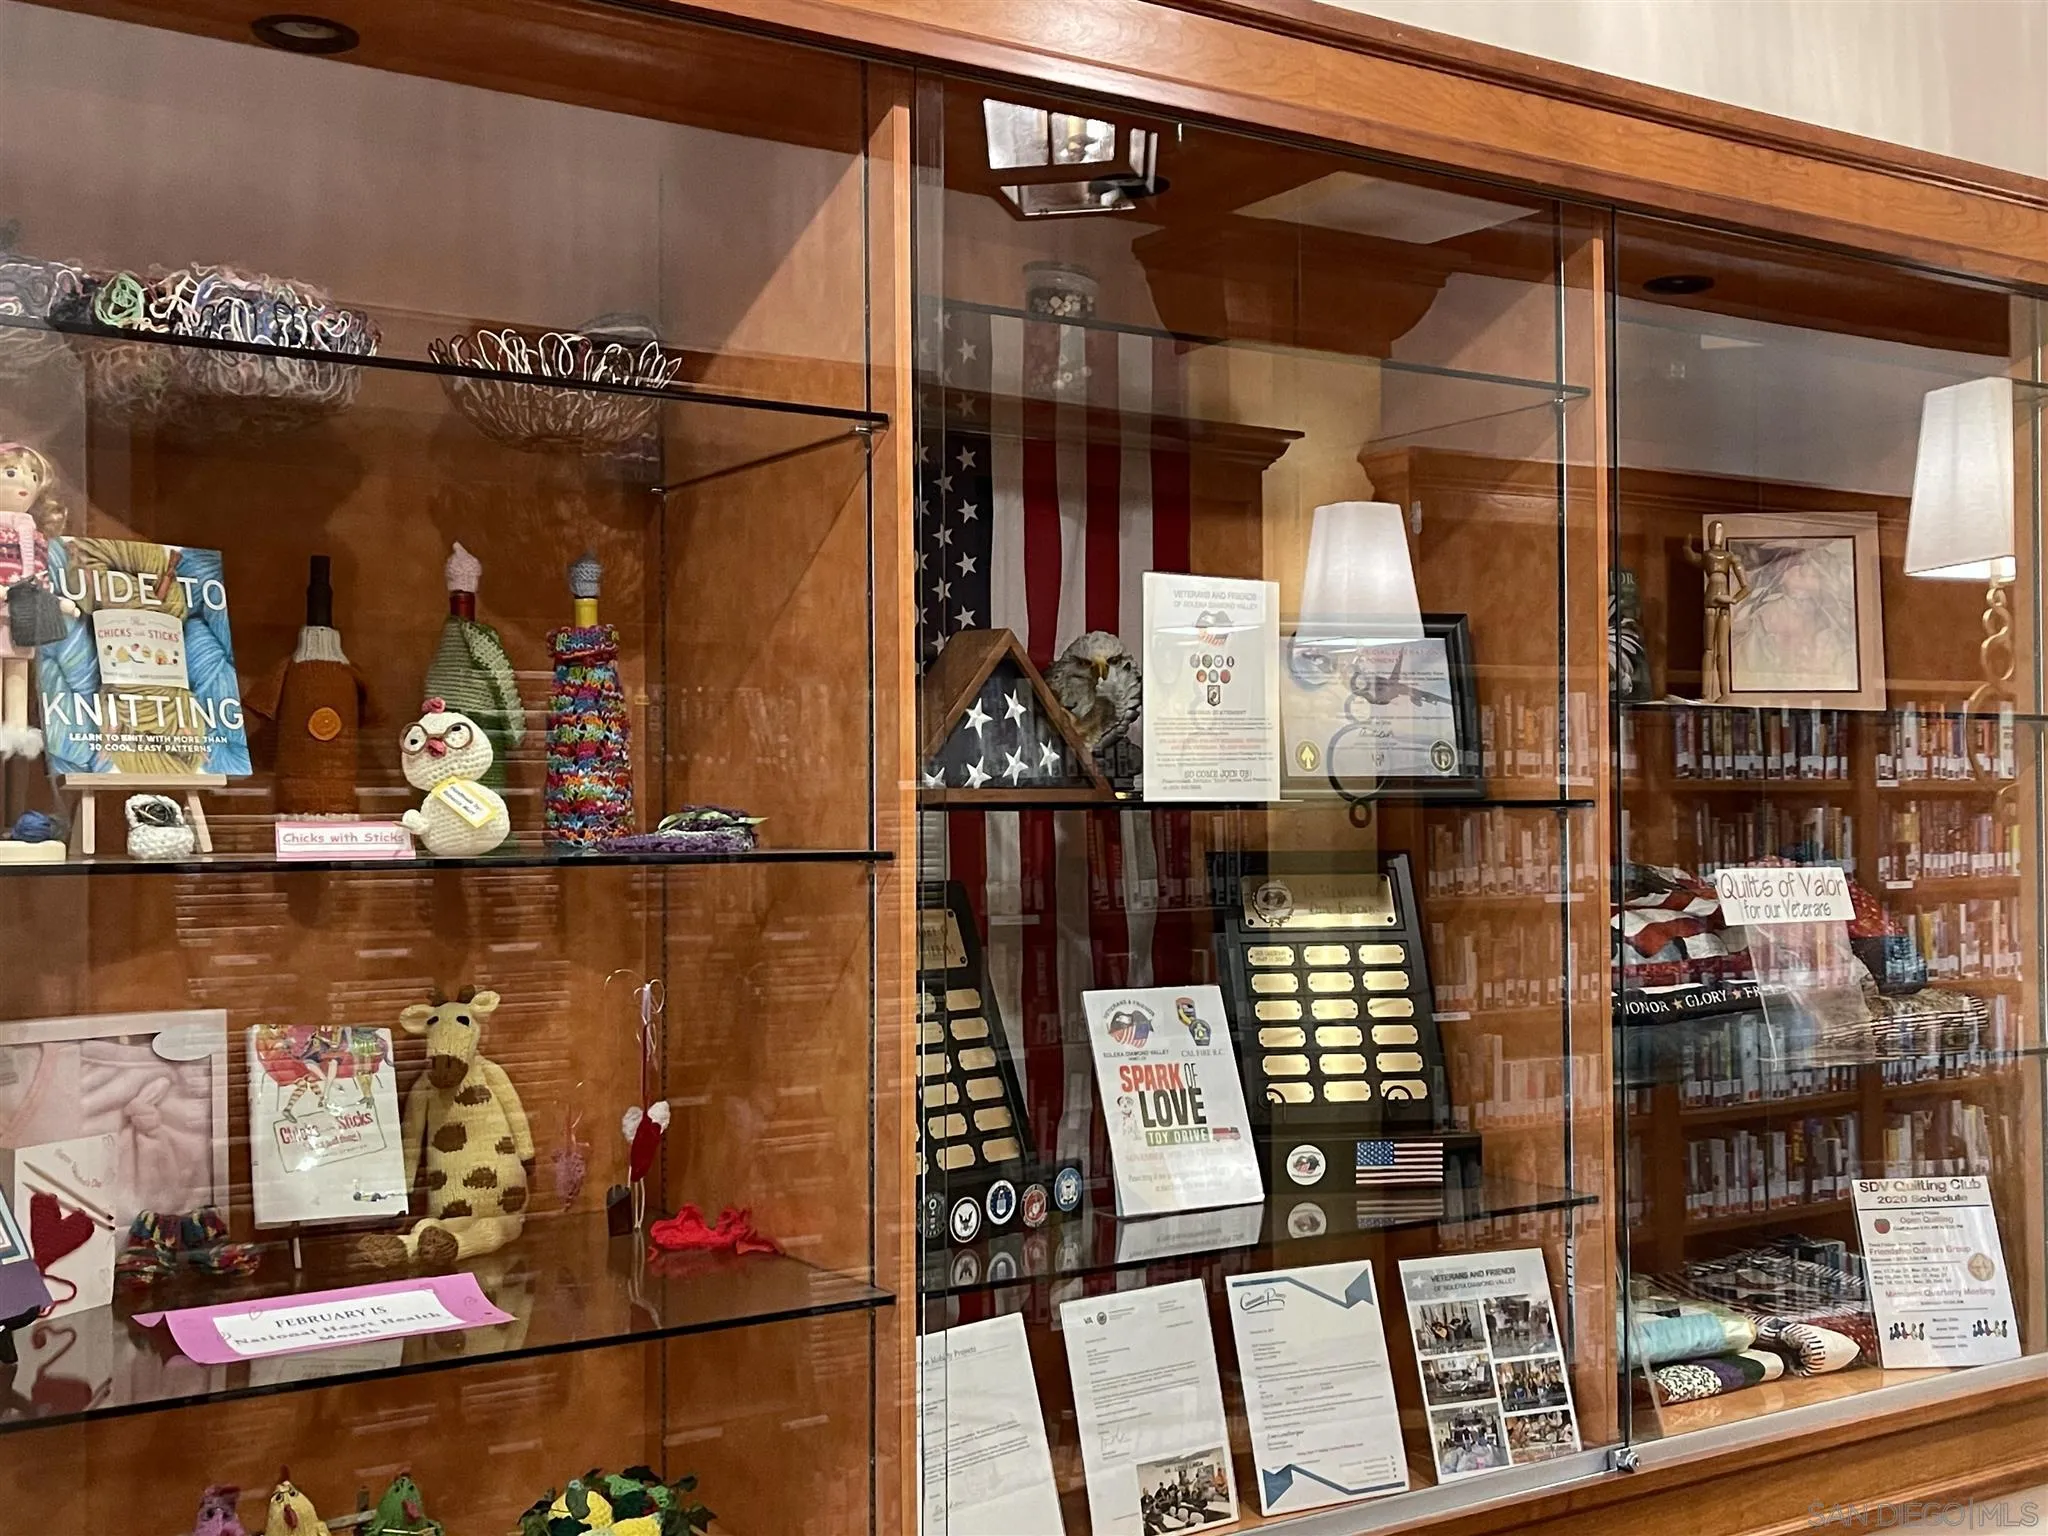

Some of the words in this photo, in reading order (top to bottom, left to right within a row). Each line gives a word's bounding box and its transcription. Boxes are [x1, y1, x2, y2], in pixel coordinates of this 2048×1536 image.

[49, 567, 162, 606] UIDE
[176, 576, 227, 611] TO
[98, 628, 132, 638] CHICKS
[147, 629, 180, 642] STICKS
[41, 691, 245, 730] KNITTING
[69, 733, 103, 742] LEARN
[106, 734, 119, 742] TO
[120, 734, 144, 743] KNIT
[145, 735, 171, 743] WITH
[202, 736, 228, 744] THAN
[89, 743, 102, 752] 30
[105, 743, 135, 753] COOL,
[137, 743, 162, 752] EASY
[165, 745, 212, 753] PATTERNS
[282, 832, 325, 844] Chicks
[329, 831, 358, 843] with
[363, 829, 405, 843] Sticks
[1719, 872, 1774, 900] Quilts
[1778, 871, 1796, 898] of
[1799, 871, 1844, 897] Valor
[1743, 900, 1760, 919] for
[1763, 903, 1781, 919] our
[1684, 988, 1729, 1008] GLORY
[1119, 1063, 1185, 1093] SPARK
[1183, 1062, 1198, 1089] OF
[1138, 1087, 1207, 1128] LOVE
[335, 1110, 374, 1130] Sticks
[1147, 1130, 1170, 1146] TOY
[1173, 1128, 1209, 1144] DRIVE
[1859, 1181, 1889, 1193] SDV
[1893, 1179, 1948, 1193] Quilting
[1950, 1177, 1981, 1190] Club
[1876, 1195, 1908, 1204] 2020
[1911, 1194, 1968, 1203] Schedule
[1430, 1271, 1469, 1283] VETERANS
[1470, 1270, 1485, 1279] AND
[1486, 1266, 1516, 1277] FRIENDS
[275, 1307, 366, 1329] FEBRUARY
[371, 1305, 388, 1316] IS
[233, 1328, 316, 1347] National
[322, 1321, 375, 1334] Heart
[380, 1311, 441, 1326] Health
[318, 1329, 382, 1341] Month
